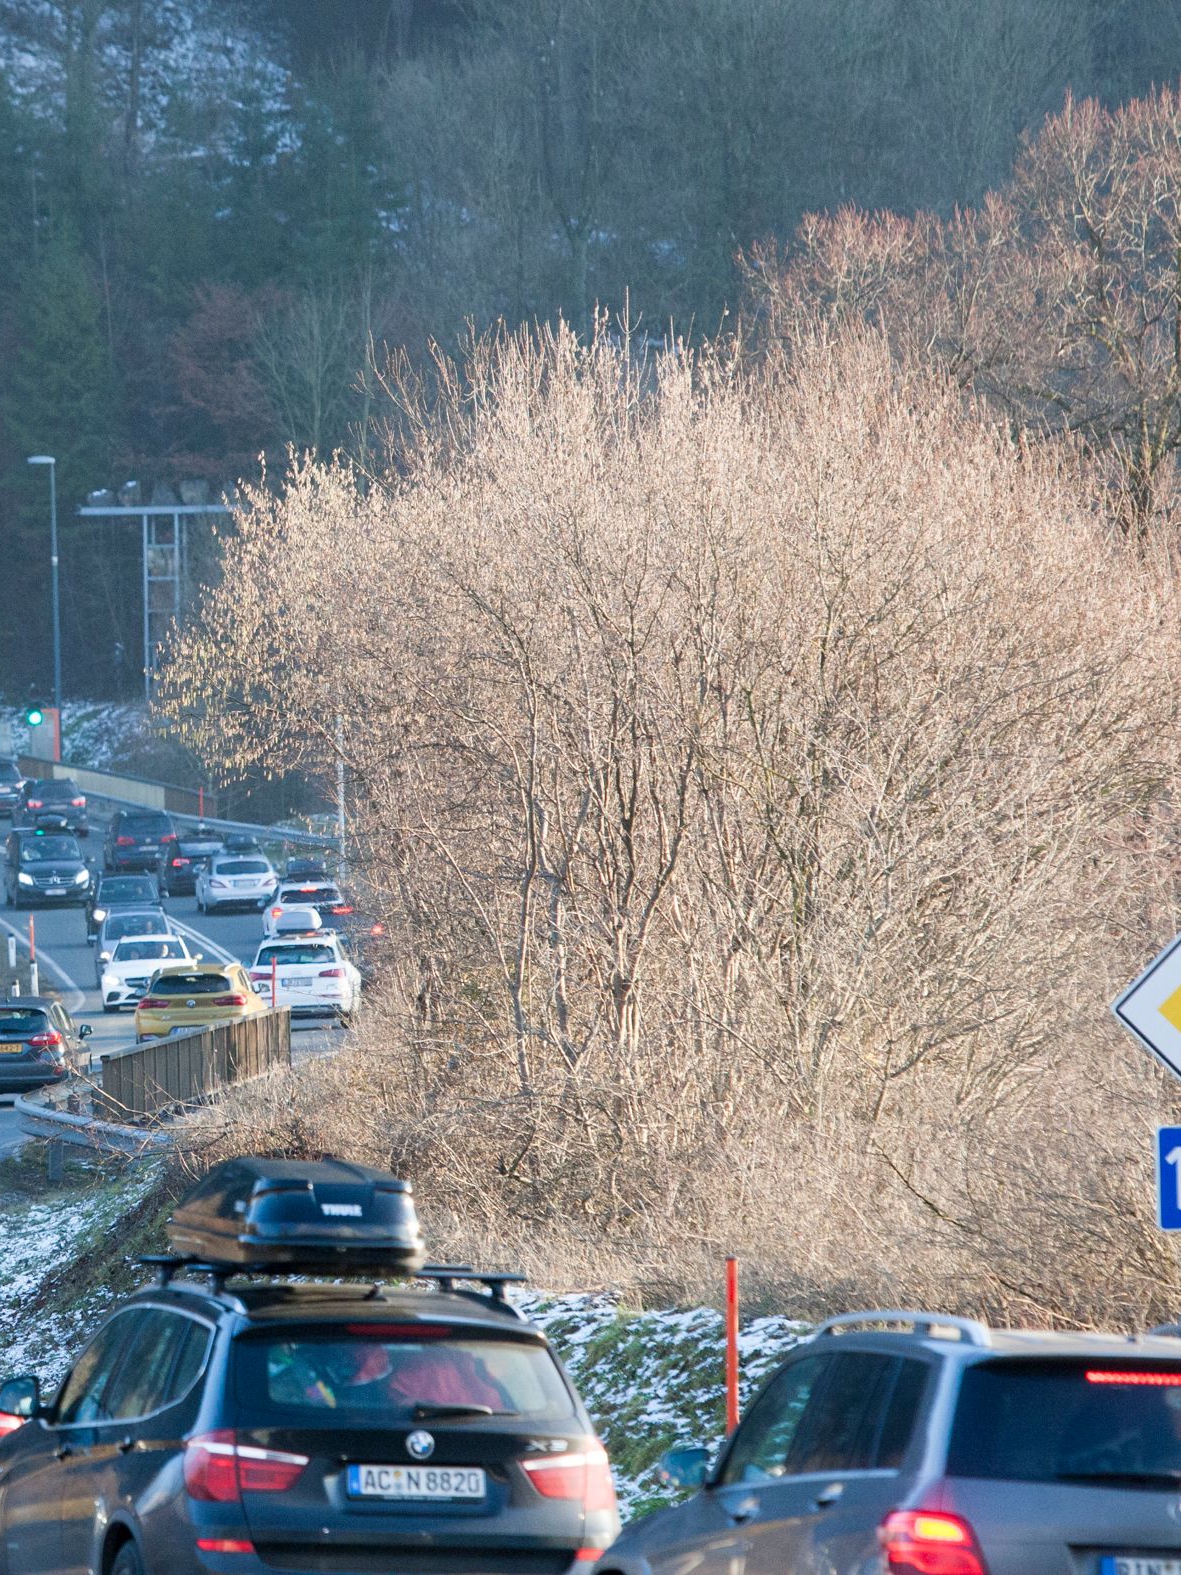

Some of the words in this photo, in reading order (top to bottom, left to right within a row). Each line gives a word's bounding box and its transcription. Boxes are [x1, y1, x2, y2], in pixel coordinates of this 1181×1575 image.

[525, 1439, 568, 1452] X3
[364, 1470, 391, 1491] AC
[406, 1471, 421, 1491] N
[426, 1471, 480, 1494] 8820
